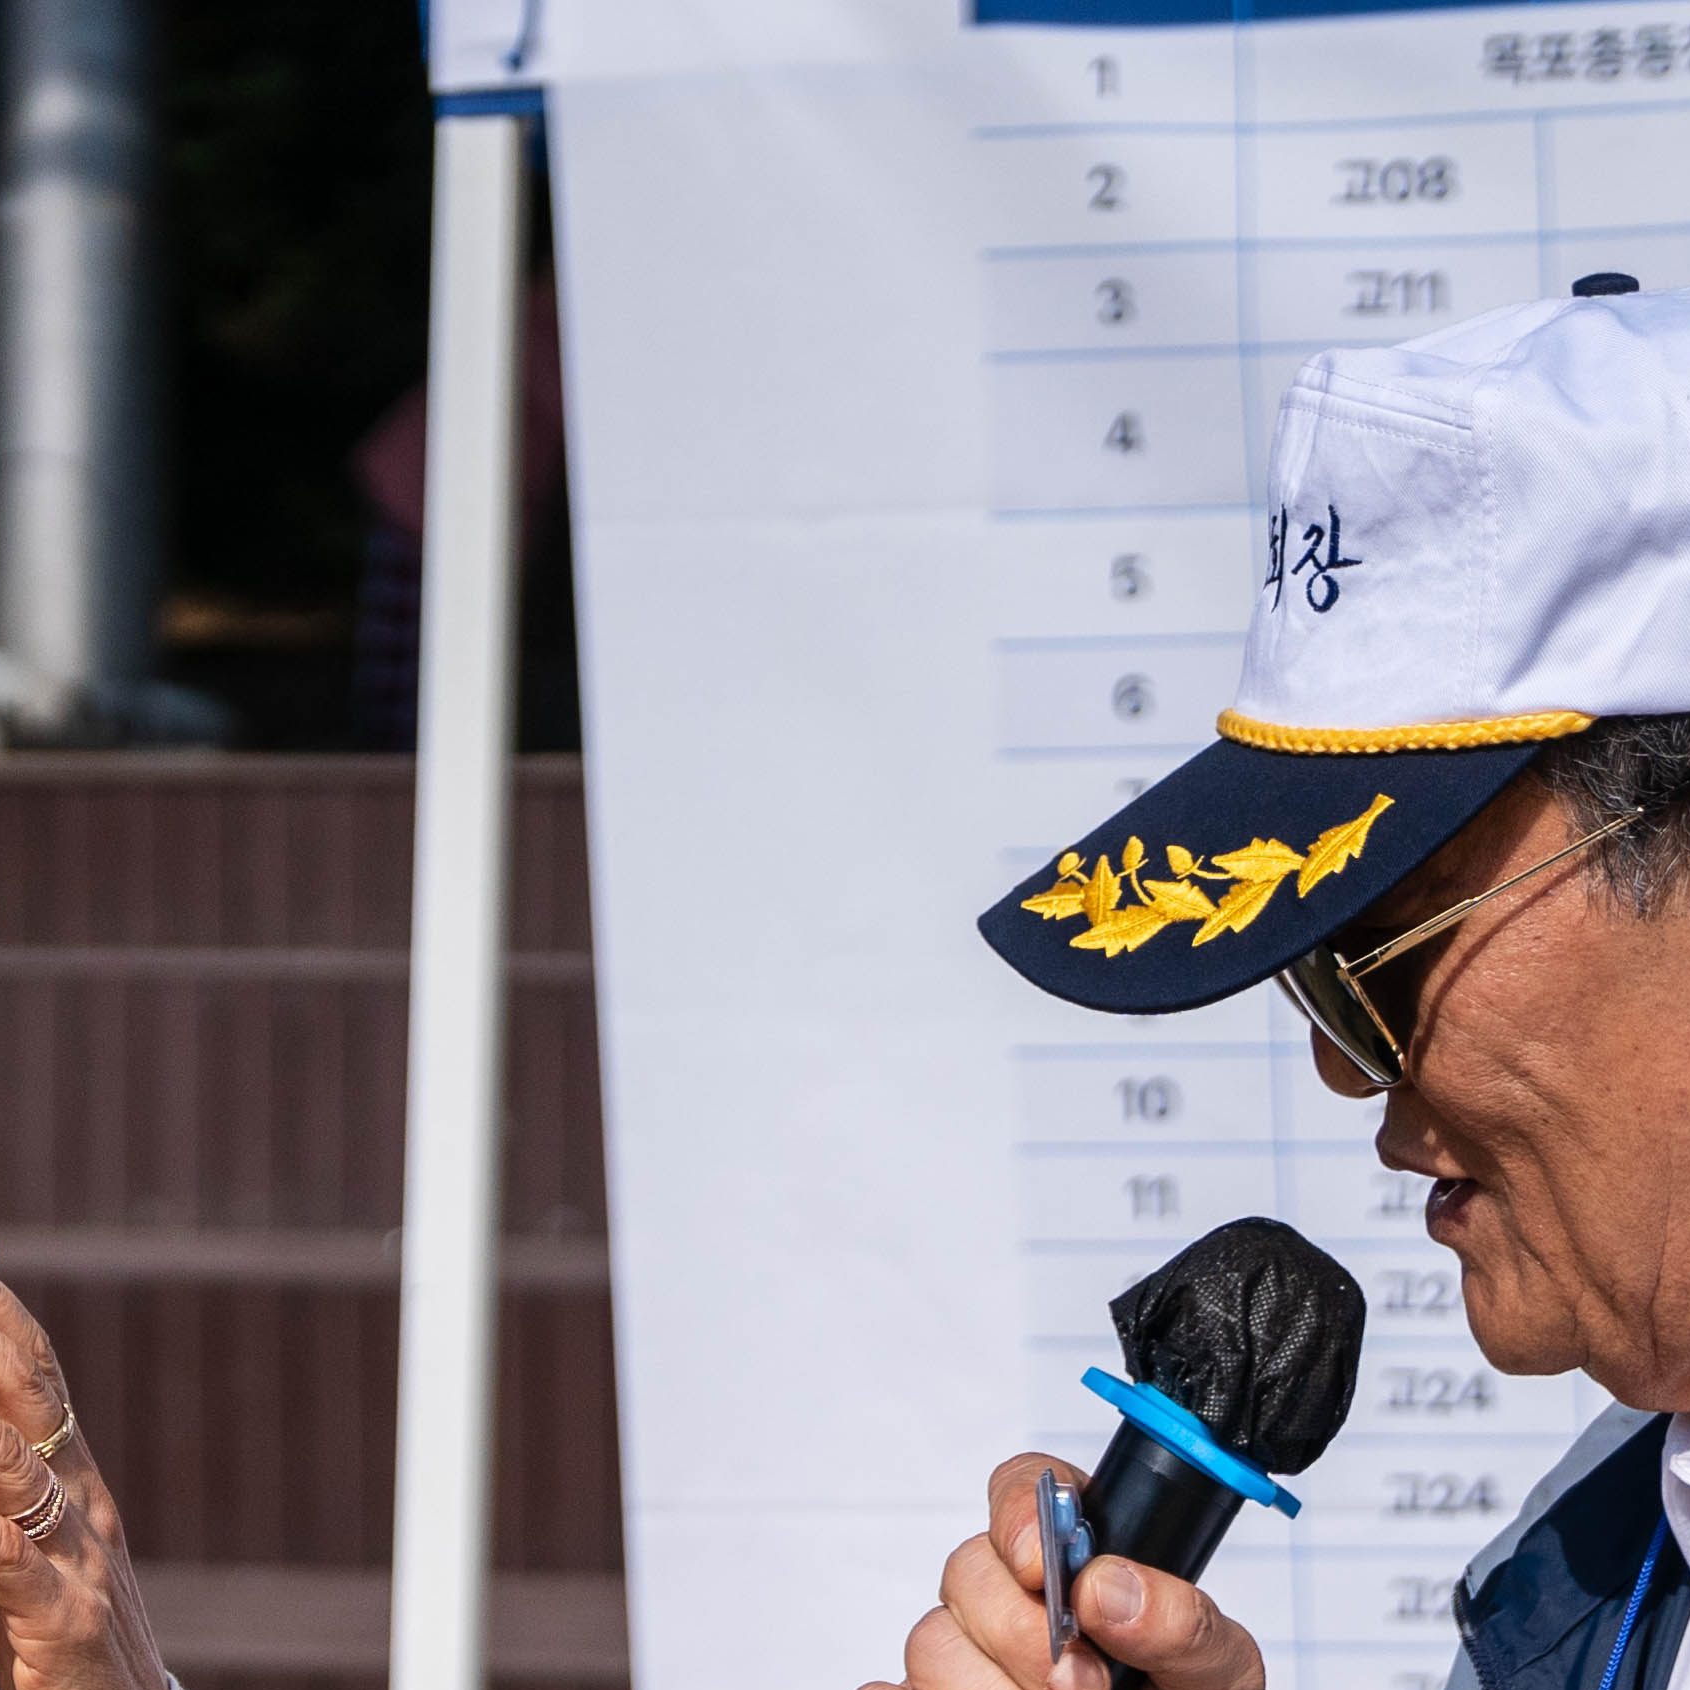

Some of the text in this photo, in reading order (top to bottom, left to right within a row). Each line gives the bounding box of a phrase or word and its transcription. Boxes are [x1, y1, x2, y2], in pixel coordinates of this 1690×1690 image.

[1088, 55, 1120, 97] 1
[1085, 164, 1125, 209] 2
[1335, 156, 1458, 204] 고08
[1096, 279, 1136, 324] 3
[1345, 269, 1448, 315] 고11
[1104, 411, 1143, 454] 4
[1111, 553, 1153, 603] 5
[1375, 1270, 1461, 1313] 고2
